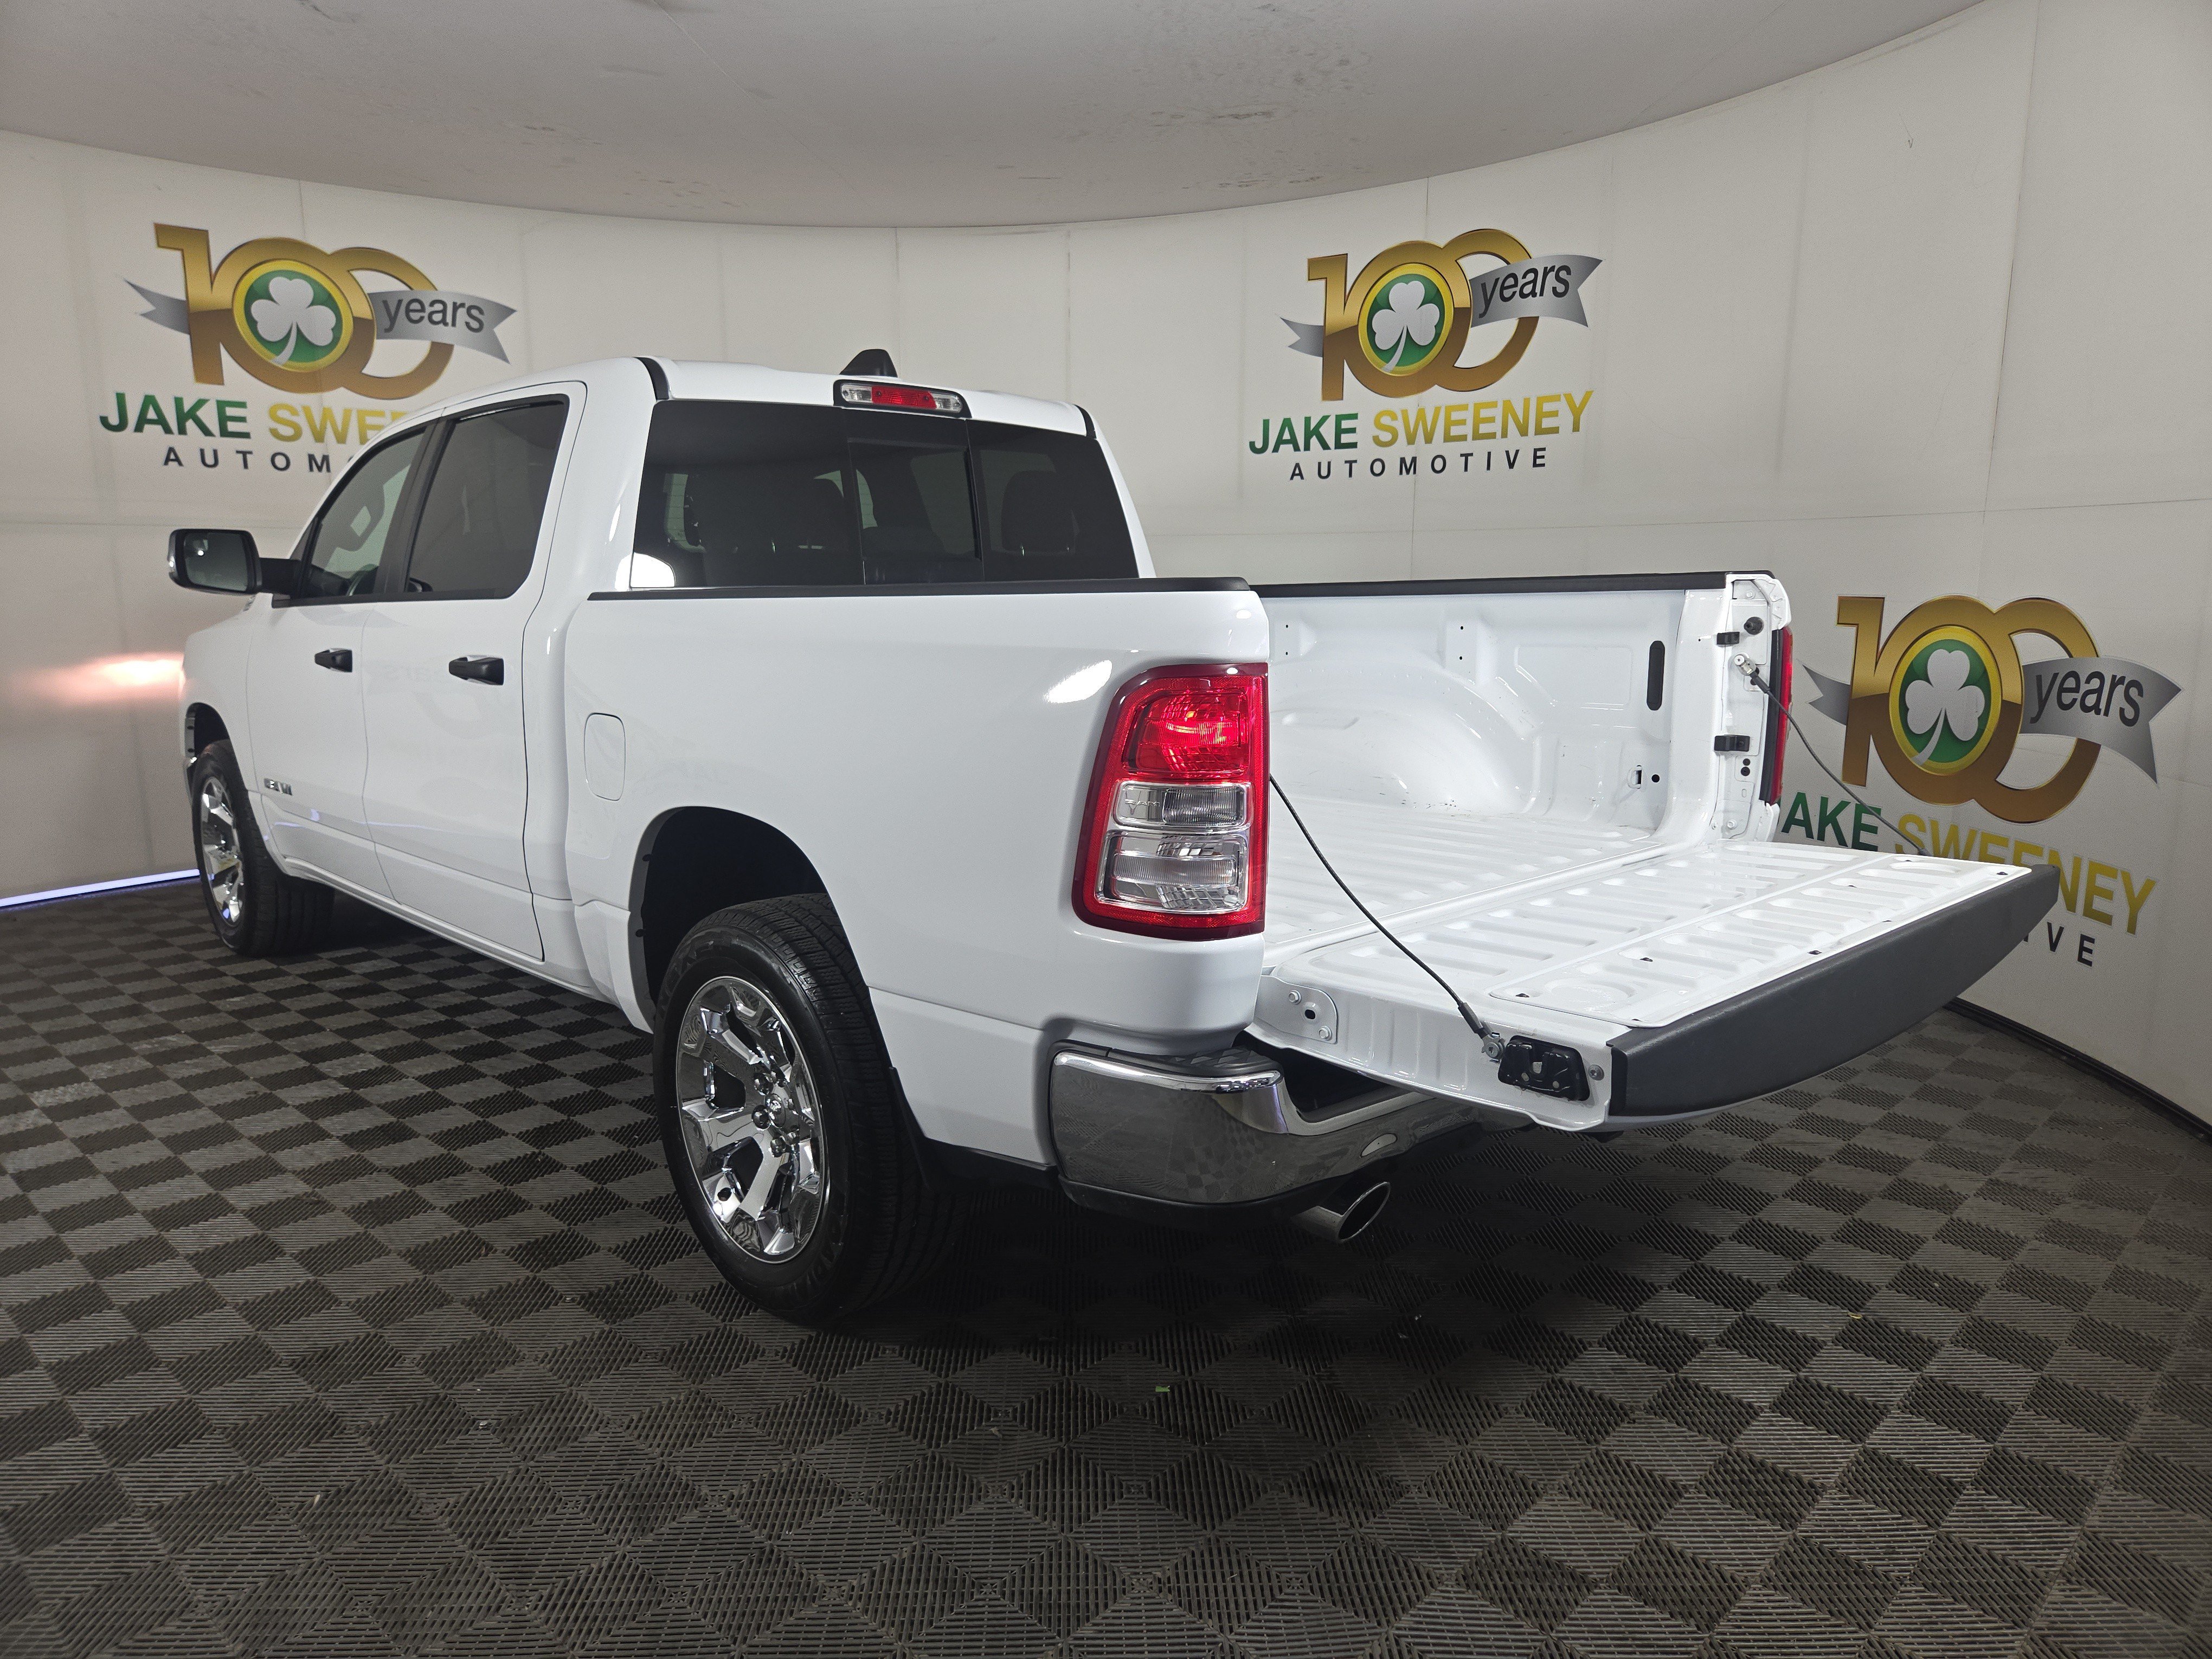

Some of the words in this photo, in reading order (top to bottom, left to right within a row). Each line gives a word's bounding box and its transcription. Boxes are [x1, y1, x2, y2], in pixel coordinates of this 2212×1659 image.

[383, 295, 485, 333] years
[1478, 264, 1571, 319] years
[99, 393, 251, 439] JAKE
[268, 404, 407, 445] SWE
[1249, 413, 1359, 454] JAKE
[1372, 390, 1594, 448] SWEENEY
[1290, 448, 1547, 481] AUTOMOTIVE
[2030, 668, 2144, 727] years
[1778, 792, 1882, 852] AKE
